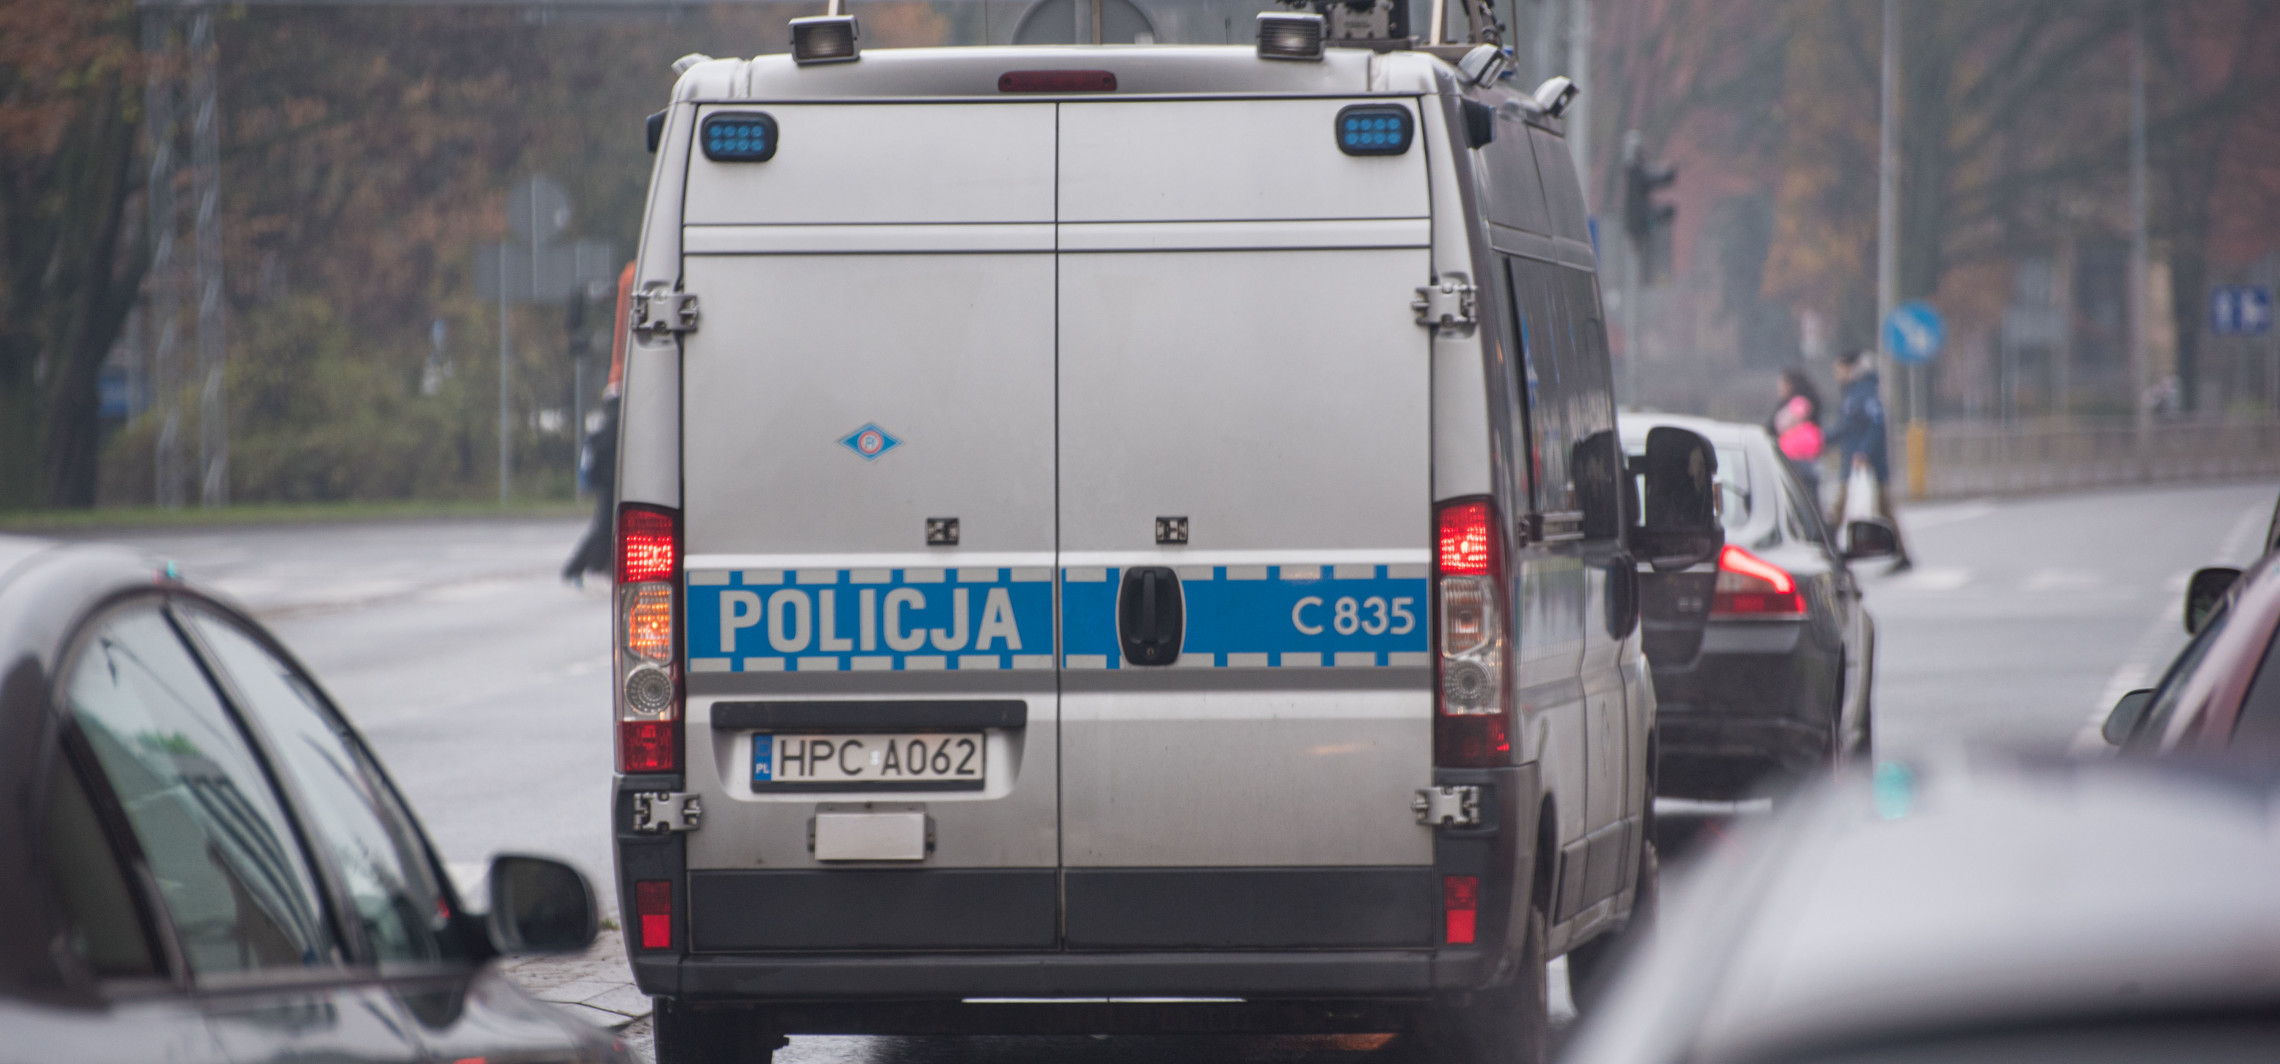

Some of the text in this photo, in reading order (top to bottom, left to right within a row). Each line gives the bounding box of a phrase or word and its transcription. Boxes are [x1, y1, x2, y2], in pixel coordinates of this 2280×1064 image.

[719, 587, 1023, 653] POLICJA
[1291, 595, 1416, 636] C 835
[755, 762, 770, 774] PL
[779, 737, 976, 777] HPC A062
